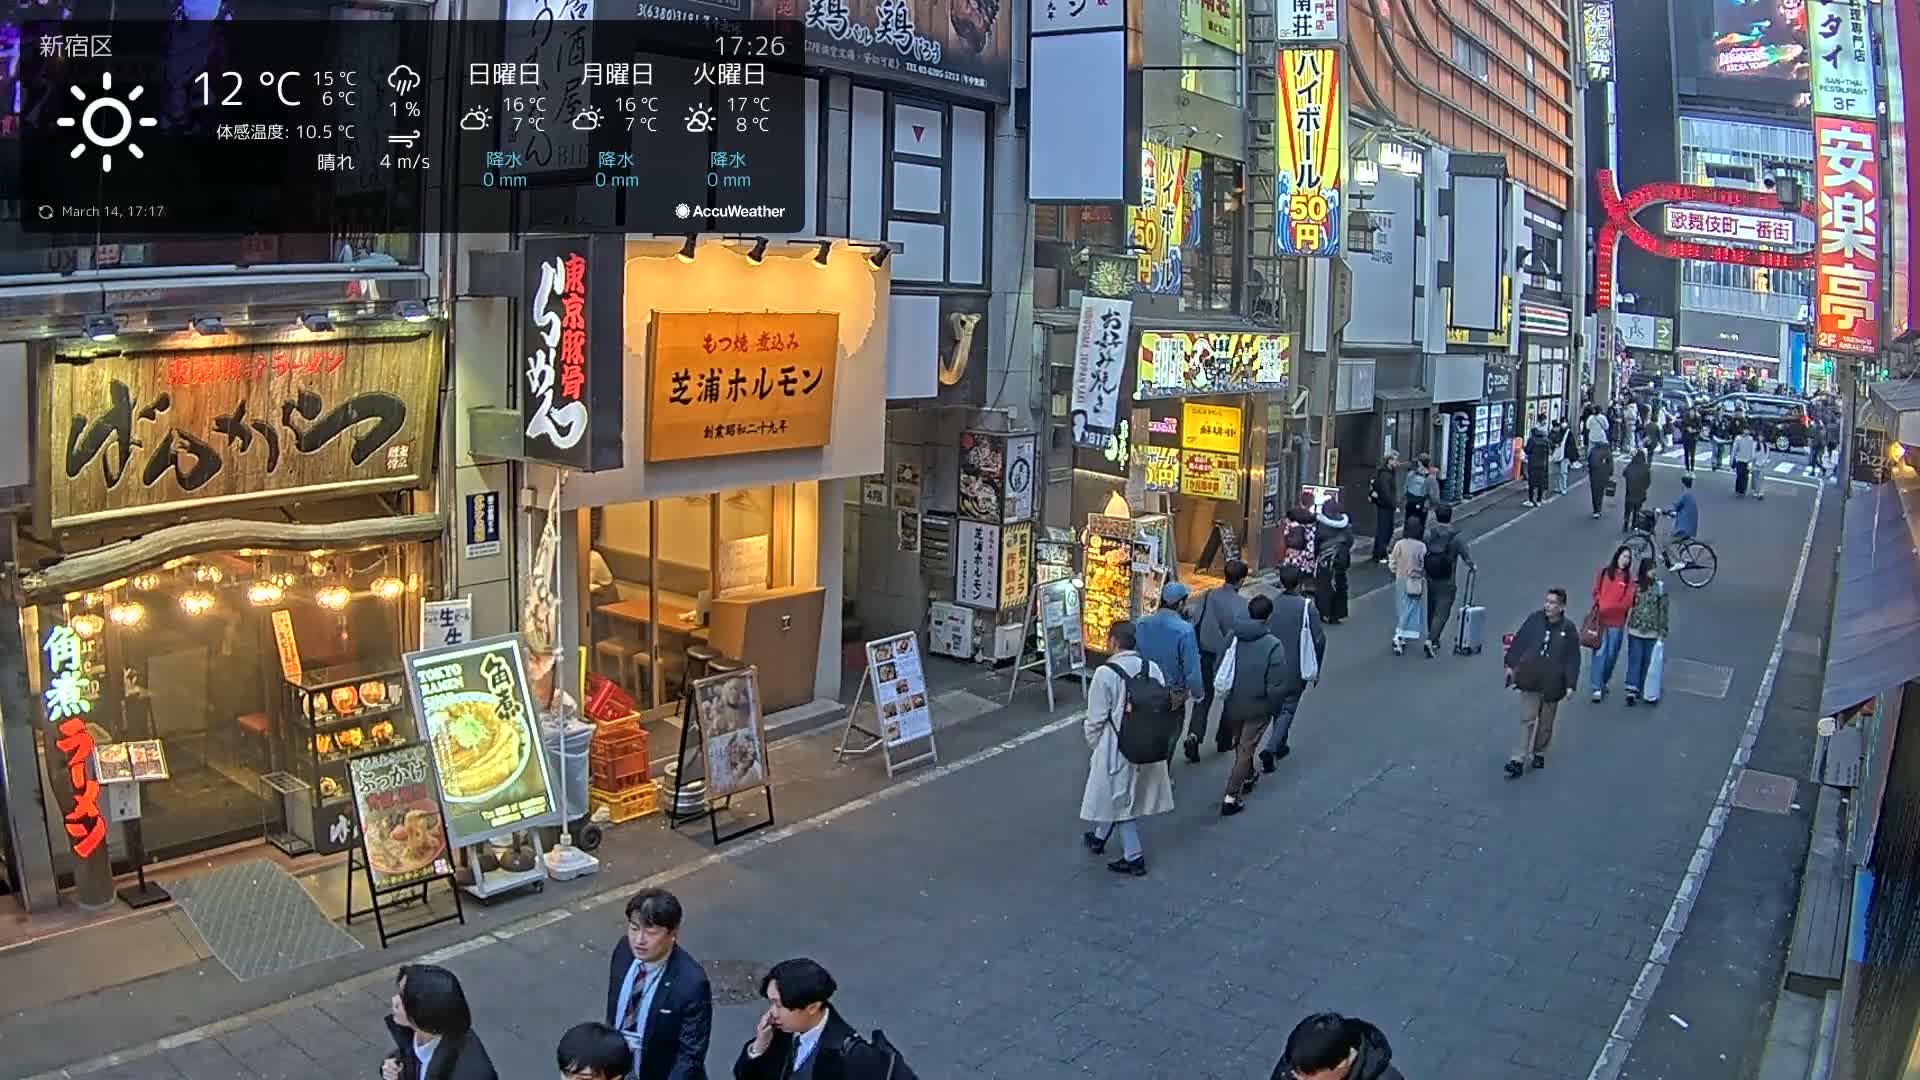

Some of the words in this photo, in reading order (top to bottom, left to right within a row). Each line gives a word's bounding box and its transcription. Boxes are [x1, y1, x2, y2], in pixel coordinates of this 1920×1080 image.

[1296, 50, 1321, 188] ハイボール
[1833, 97, 1856, 111] 3F
[1289, 195, 1327, 221] 50
[1134, 218, 1157, 251] 50
[1295, 224, 1320, 250] 円
[1671, 210, 1790, 242] 歌舞伎町一番街
[1819, 126, 1876, 330] 安楽亭
[562, 253, 586, 400] 東京豚骨
[702, 331, 749, 354] もつ焼
[755, 329, 801, 354] 煮込み
[1818, 332, 1837, 347] 2F
[1089, 308, 1124, 414] お好み焼き
[668, 365, 824, 405] 芝浦ホルモン
[702, 419, 790, 440] 創業昭和二十九年
[972, 527, 984, 600] 芝浦ホルモン
[483, 655, 521, 721] 角煮
[359, 760, 428, 793] ぶっかけ
